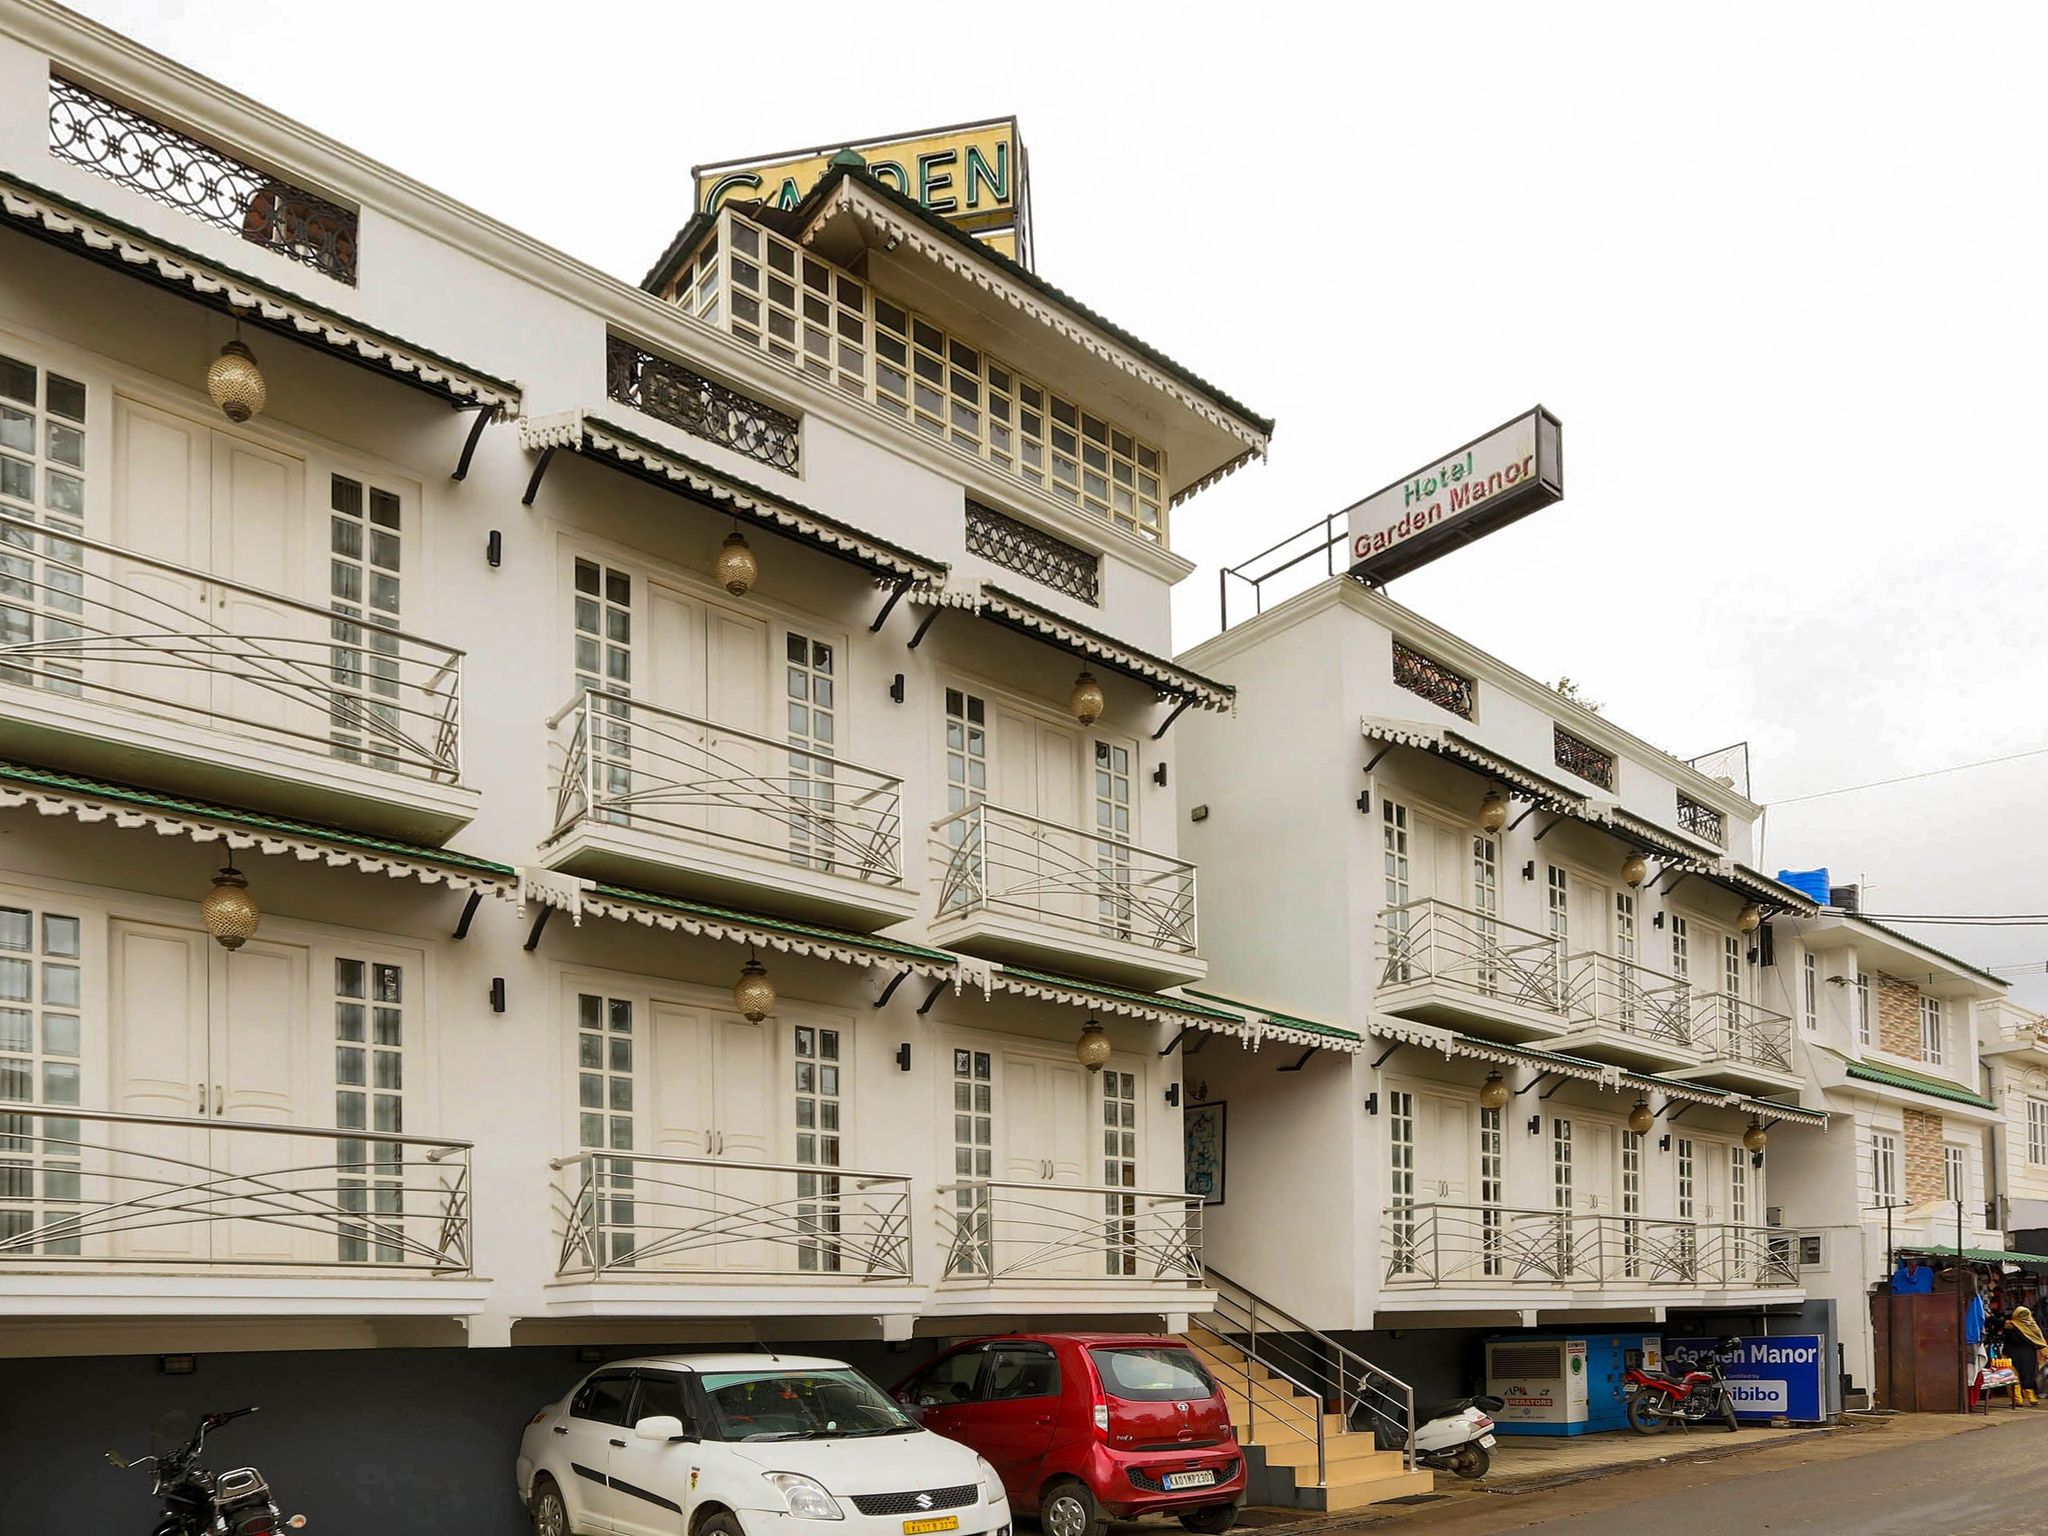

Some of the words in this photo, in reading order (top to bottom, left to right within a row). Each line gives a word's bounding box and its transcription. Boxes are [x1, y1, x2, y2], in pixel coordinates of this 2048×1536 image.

[705, 140, 1009, 214] GADEN
[1354, 503, 1442, 559] Garden
[1449, 454, 1534, 512] Manor
[1403, 452, 1473, 508] Hotel
[1674, 1345, 1745, 1364] Garen
[1751, 1344, 1817, 1364] Manor
[1730, 1387, 1780, 1401] ibibo
